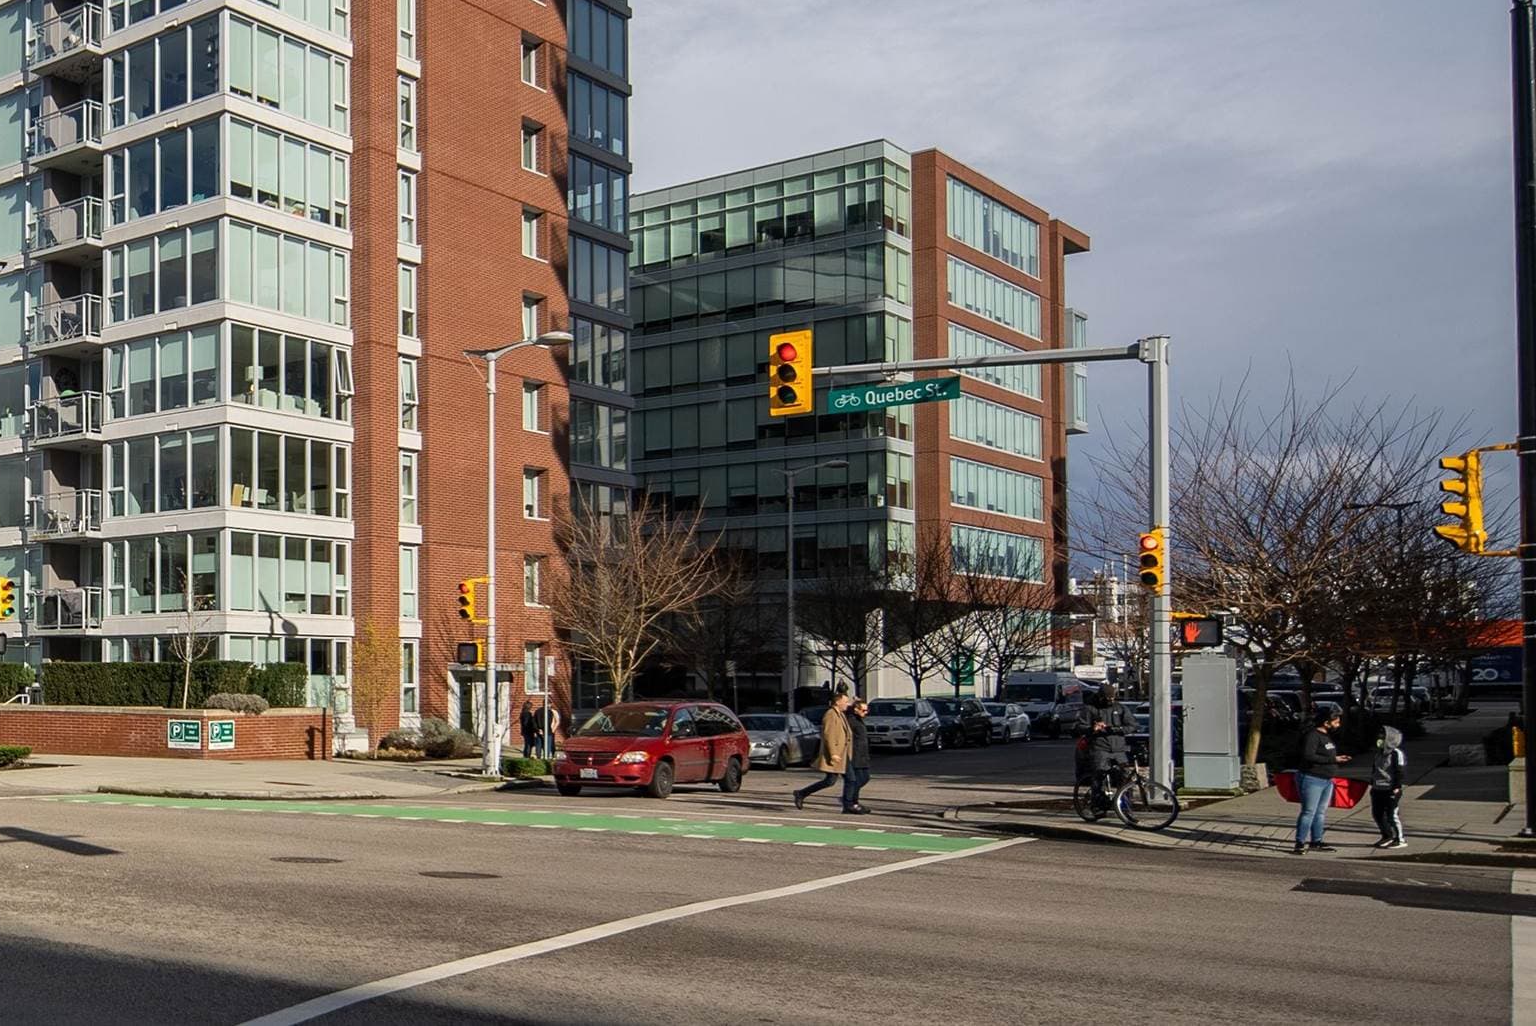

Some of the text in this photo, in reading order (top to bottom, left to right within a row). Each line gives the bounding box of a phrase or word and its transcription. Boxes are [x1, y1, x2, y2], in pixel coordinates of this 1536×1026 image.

[865, 383, 947, 405] Quebec St.
[1472, 668, 1499, 681] 20
[173, 725, 181, 737] P
[213, 725, 220, 737] P
